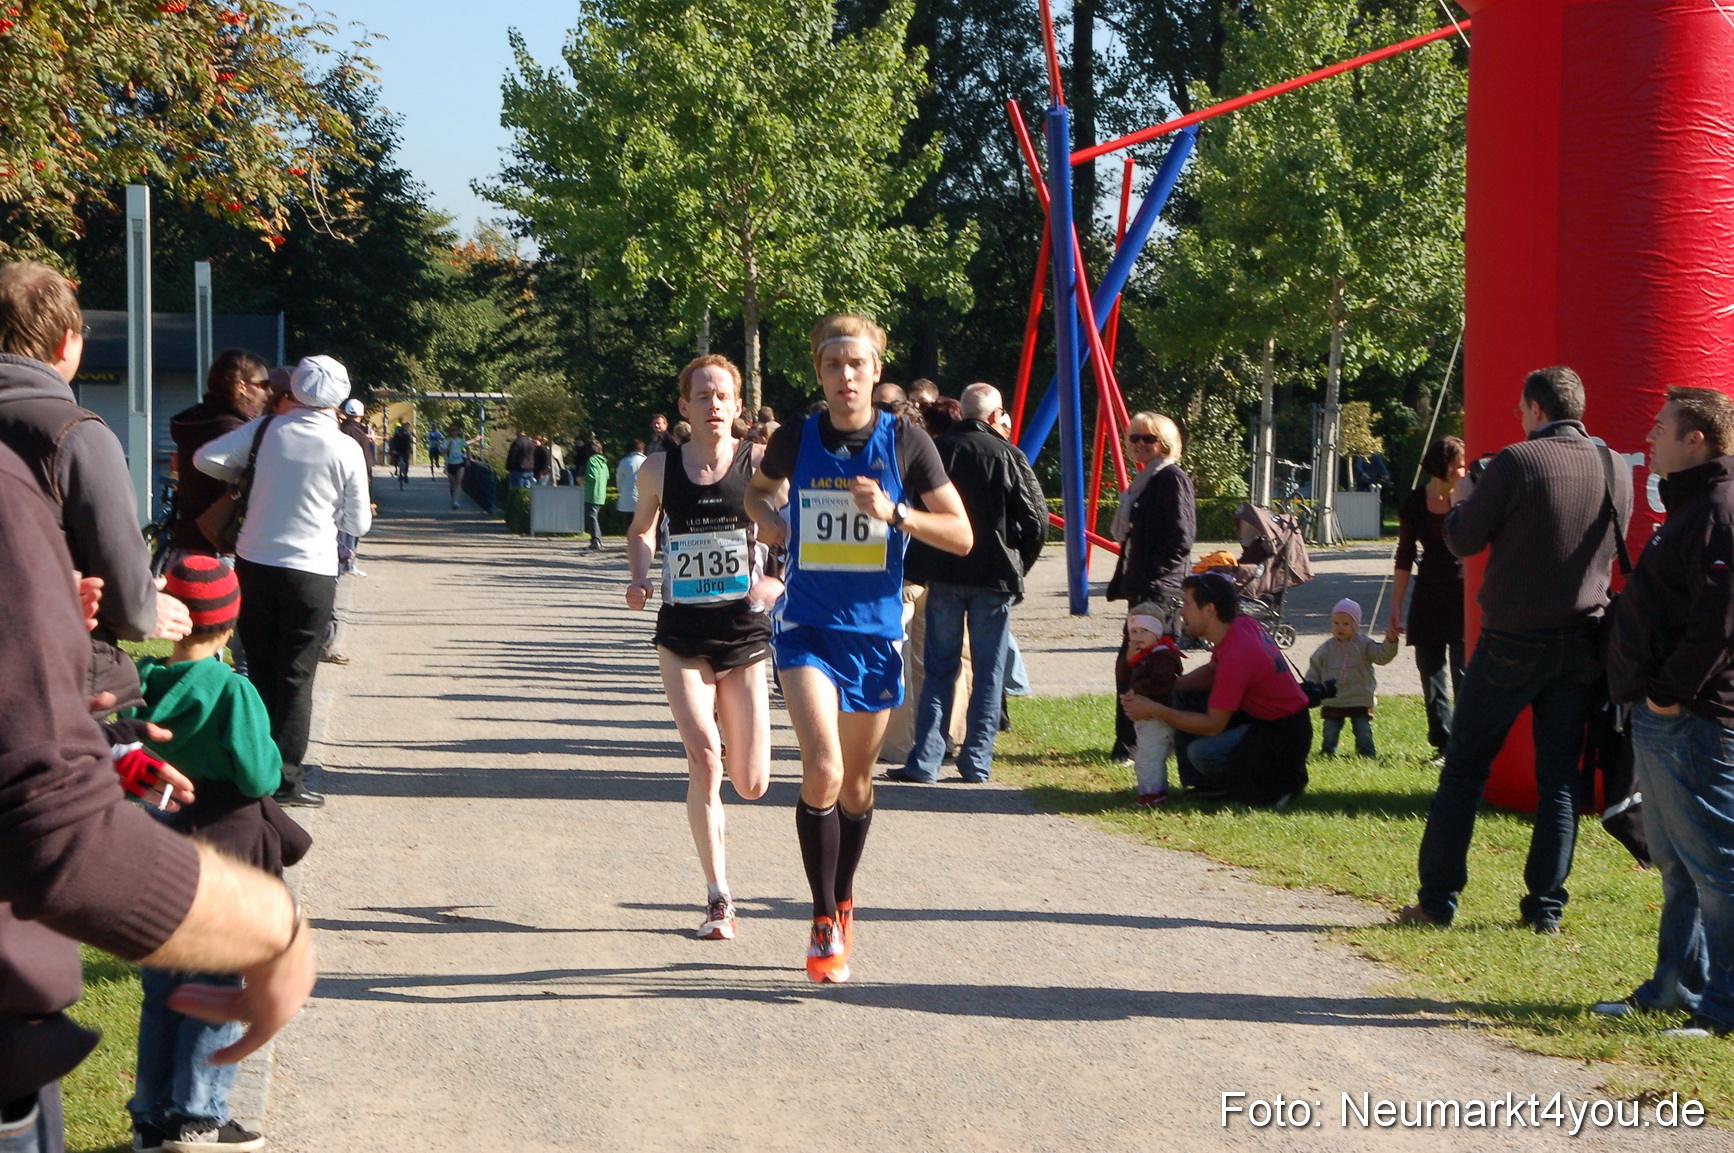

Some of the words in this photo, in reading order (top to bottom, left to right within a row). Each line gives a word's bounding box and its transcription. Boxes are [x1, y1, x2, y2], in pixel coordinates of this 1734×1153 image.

[811, 477, 832, 489] LAC
[703, 516, 738, 525] Marathon
[816, 512, 870, 542] 916
[677, 550, 740, 578] 2135
[696, 579, 725, 594] Jörg
